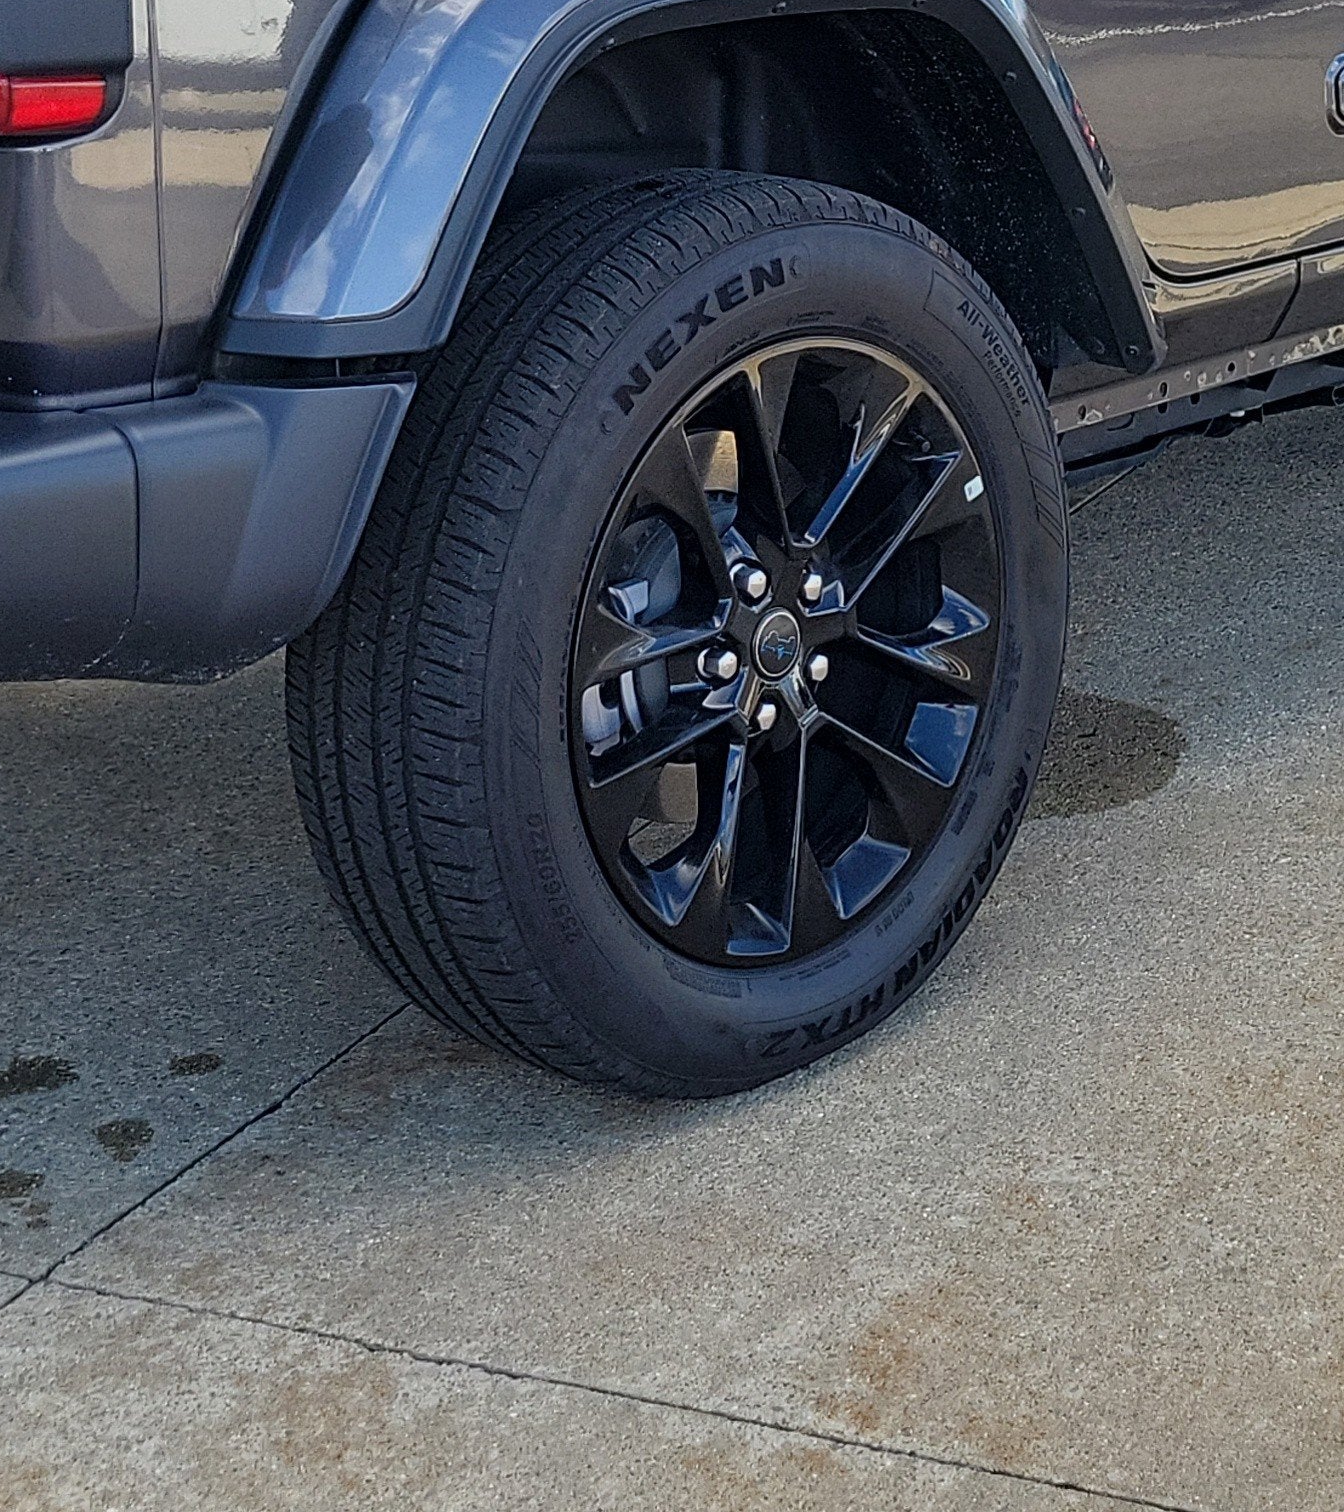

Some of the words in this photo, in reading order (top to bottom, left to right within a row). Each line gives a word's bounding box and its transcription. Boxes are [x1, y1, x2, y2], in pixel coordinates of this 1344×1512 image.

[611, 257, 786, 415] NEXEN
[957, 298, 1031, 407] All-Weather
[893, 766, 1030, 995] ROADIAN
